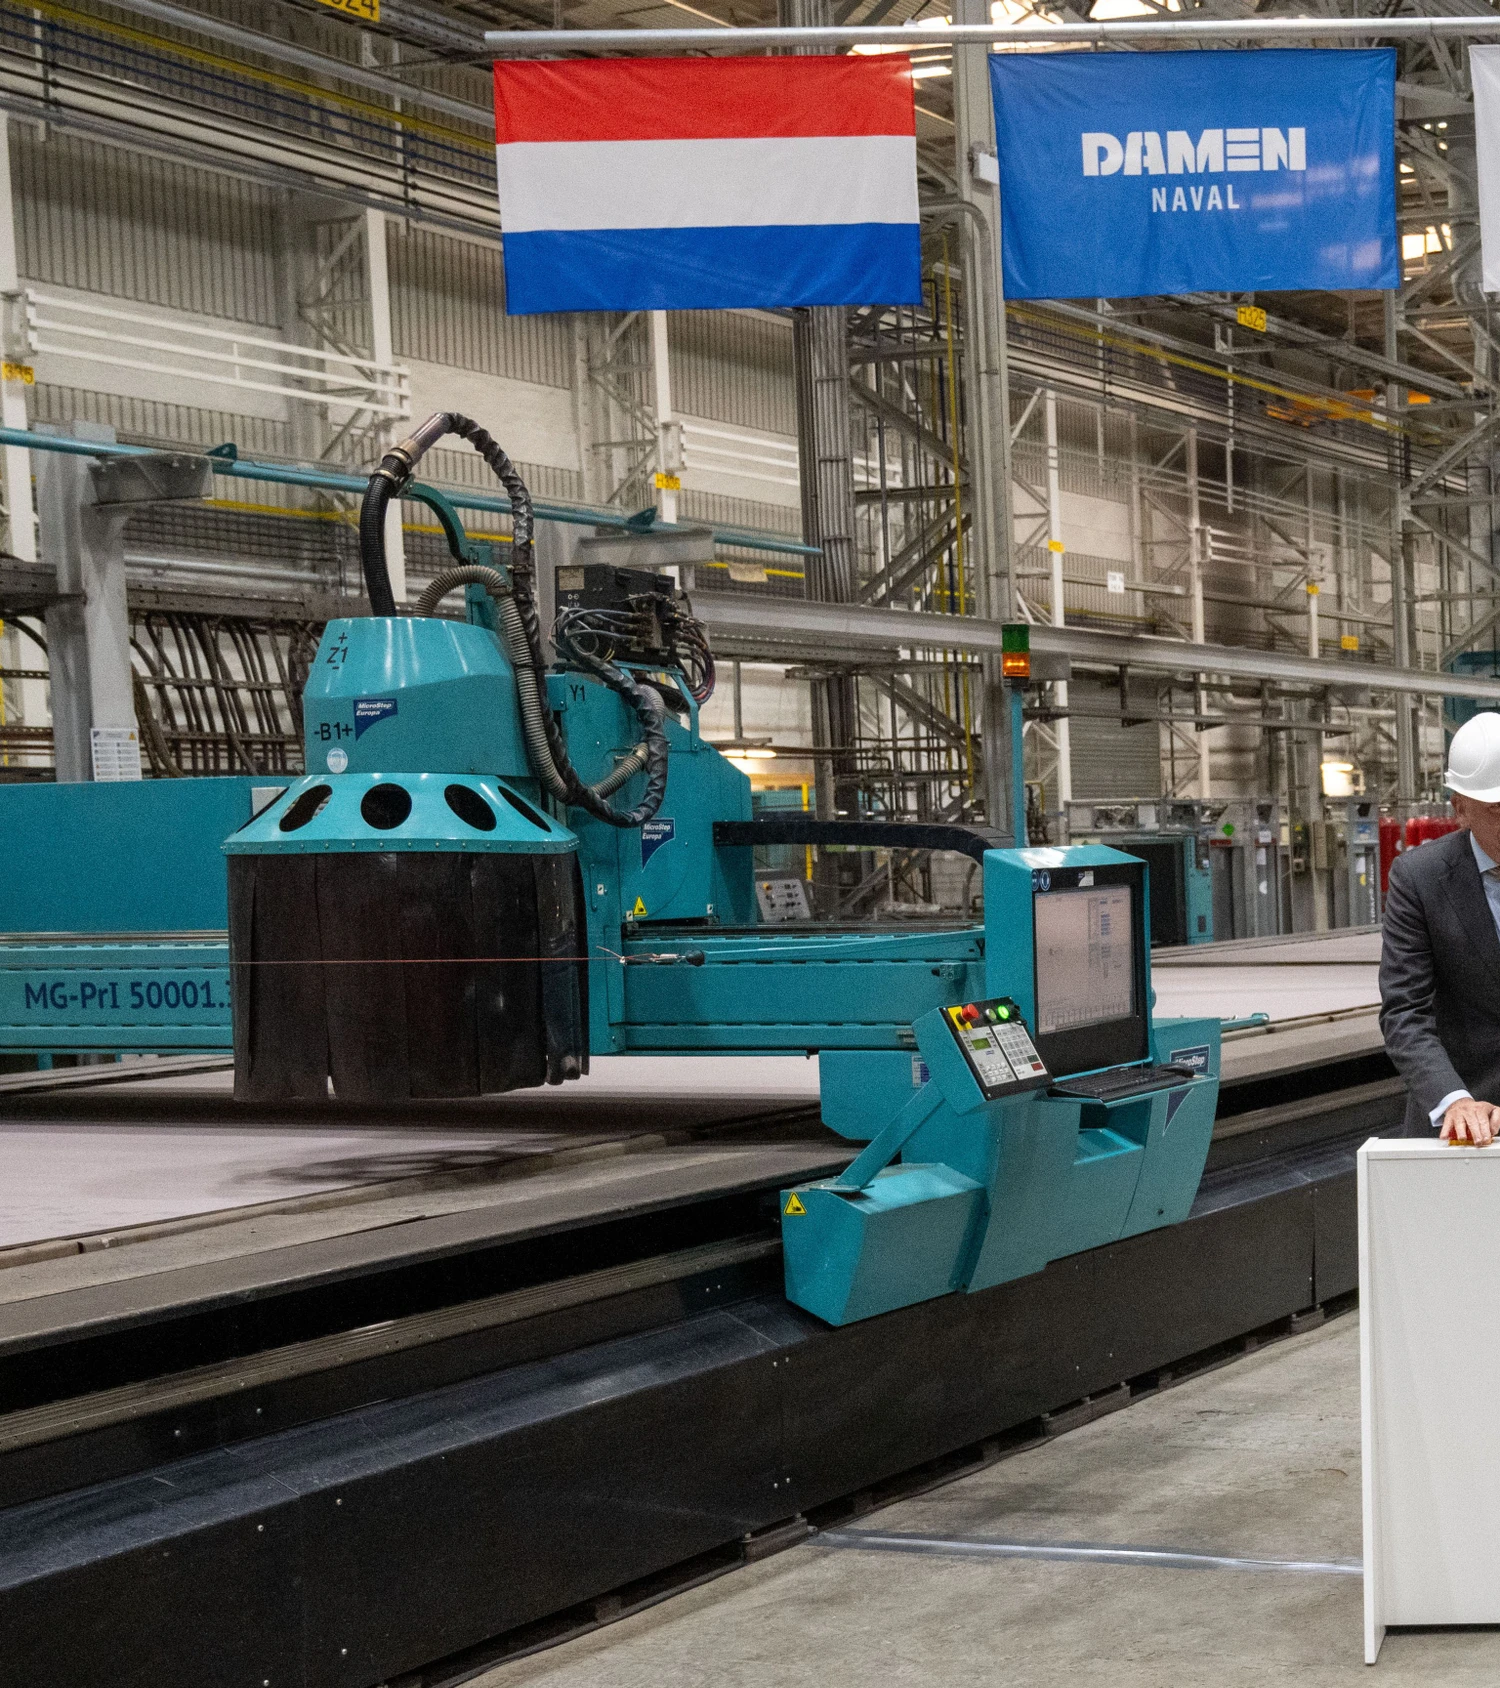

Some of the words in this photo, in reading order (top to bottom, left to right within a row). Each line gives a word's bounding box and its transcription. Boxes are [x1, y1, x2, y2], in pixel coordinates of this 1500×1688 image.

[1081, 127, 1307, 177] DAMEN
[1152, 184, 1240, 213] NAVAL
[569, 684, 586, 702] Y1
[358, 702, 392, 710] MicroStep
